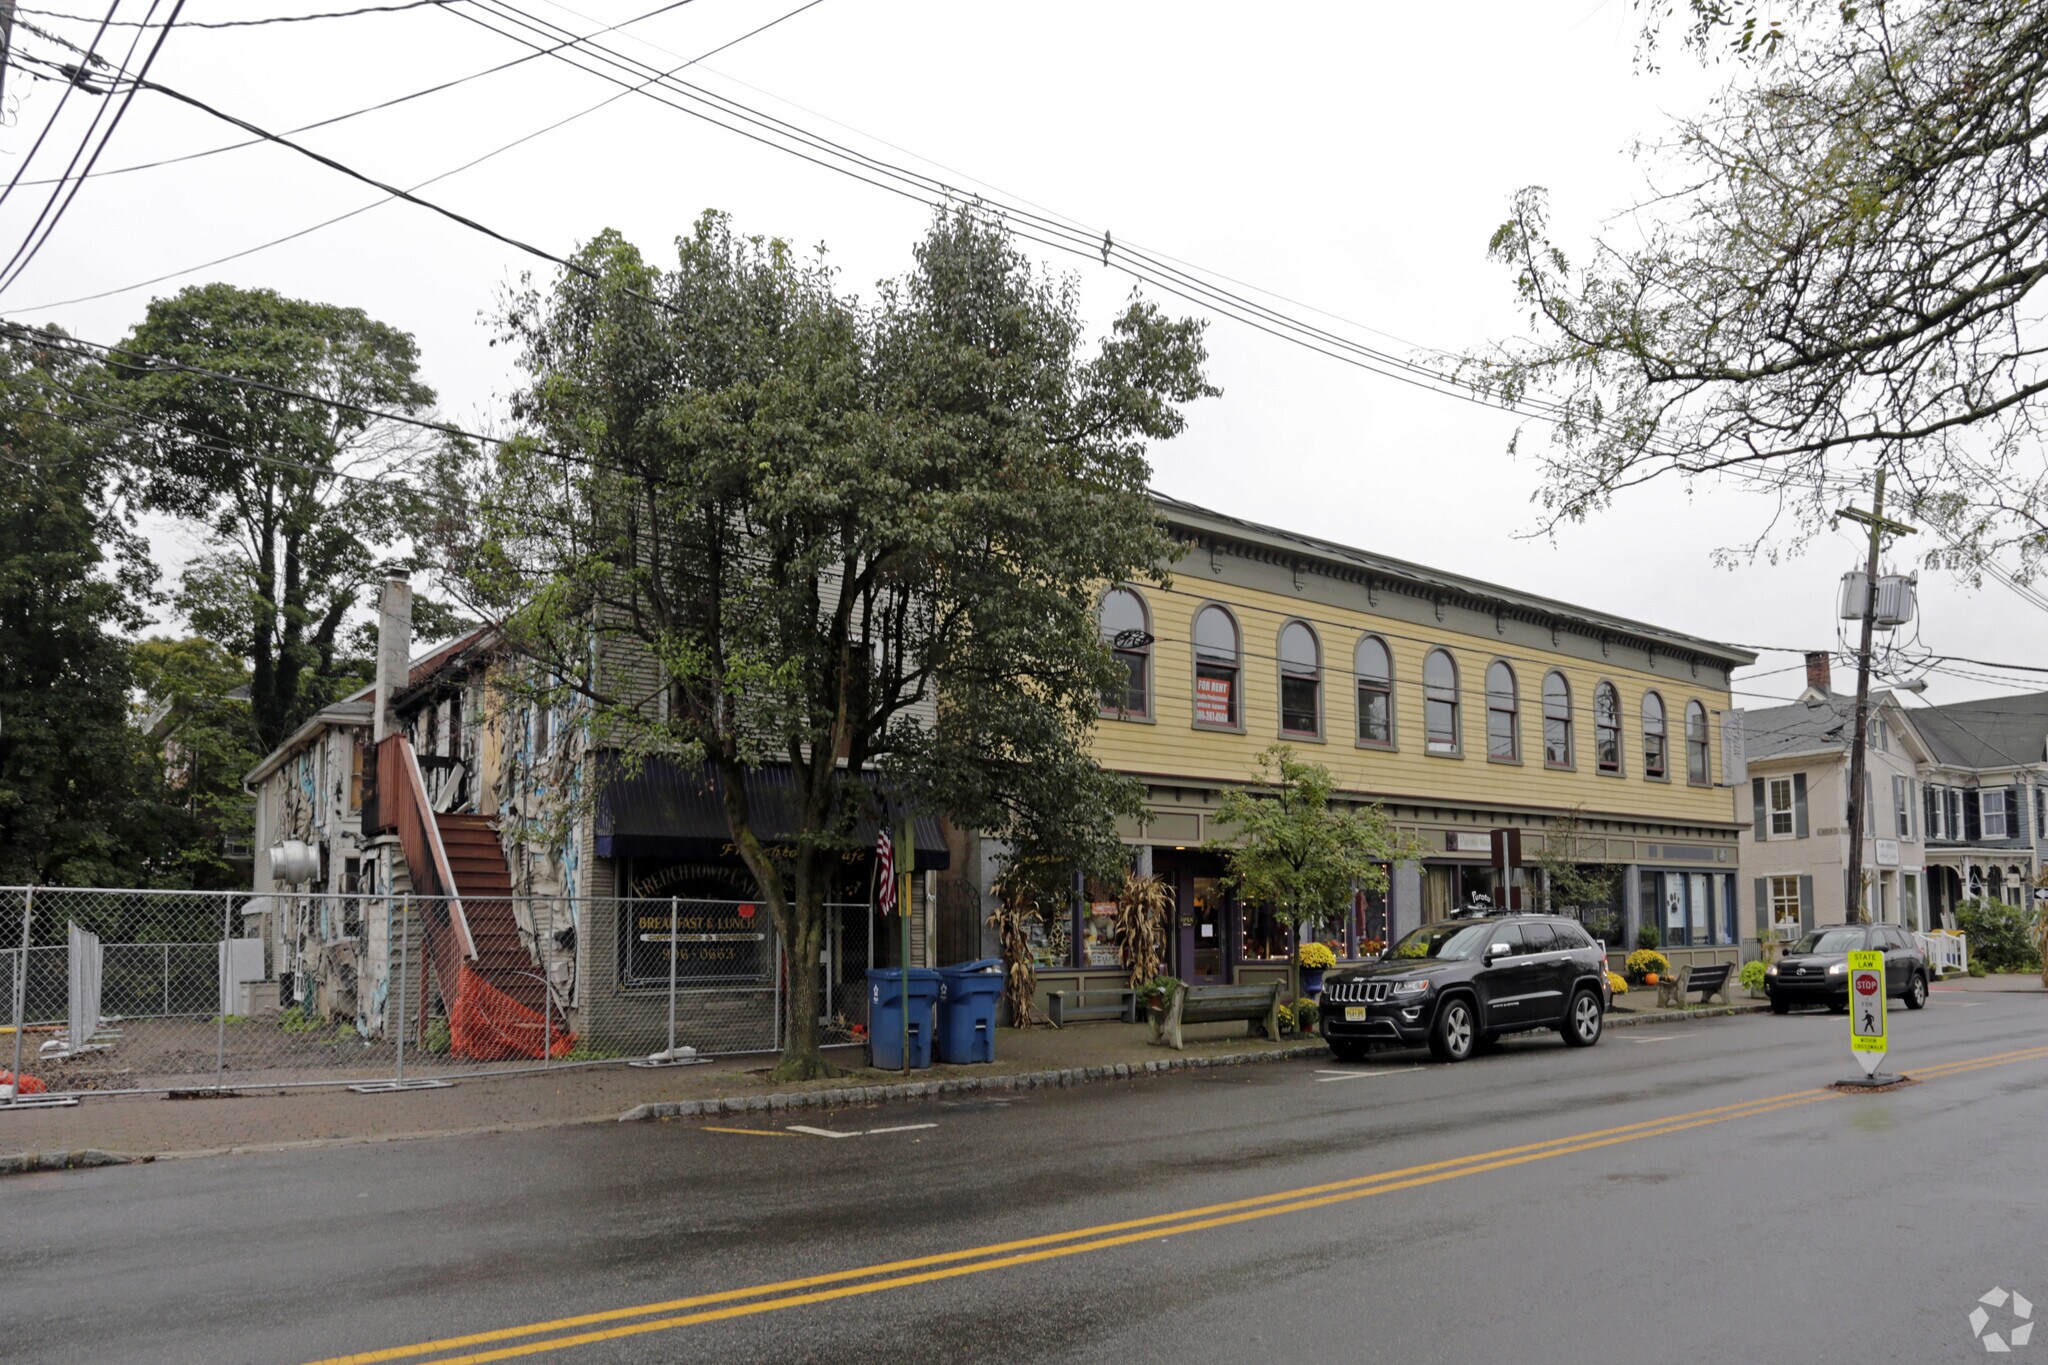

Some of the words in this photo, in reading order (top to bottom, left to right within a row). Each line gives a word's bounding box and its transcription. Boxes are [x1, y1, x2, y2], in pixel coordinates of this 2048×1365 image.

[1198, 679, 1210, 691] FOR
[1211, 681, 1227, 693] RENT
[718, 917, 756, 929] LUNCH
[1856, 981, 1877, 989] STOP
